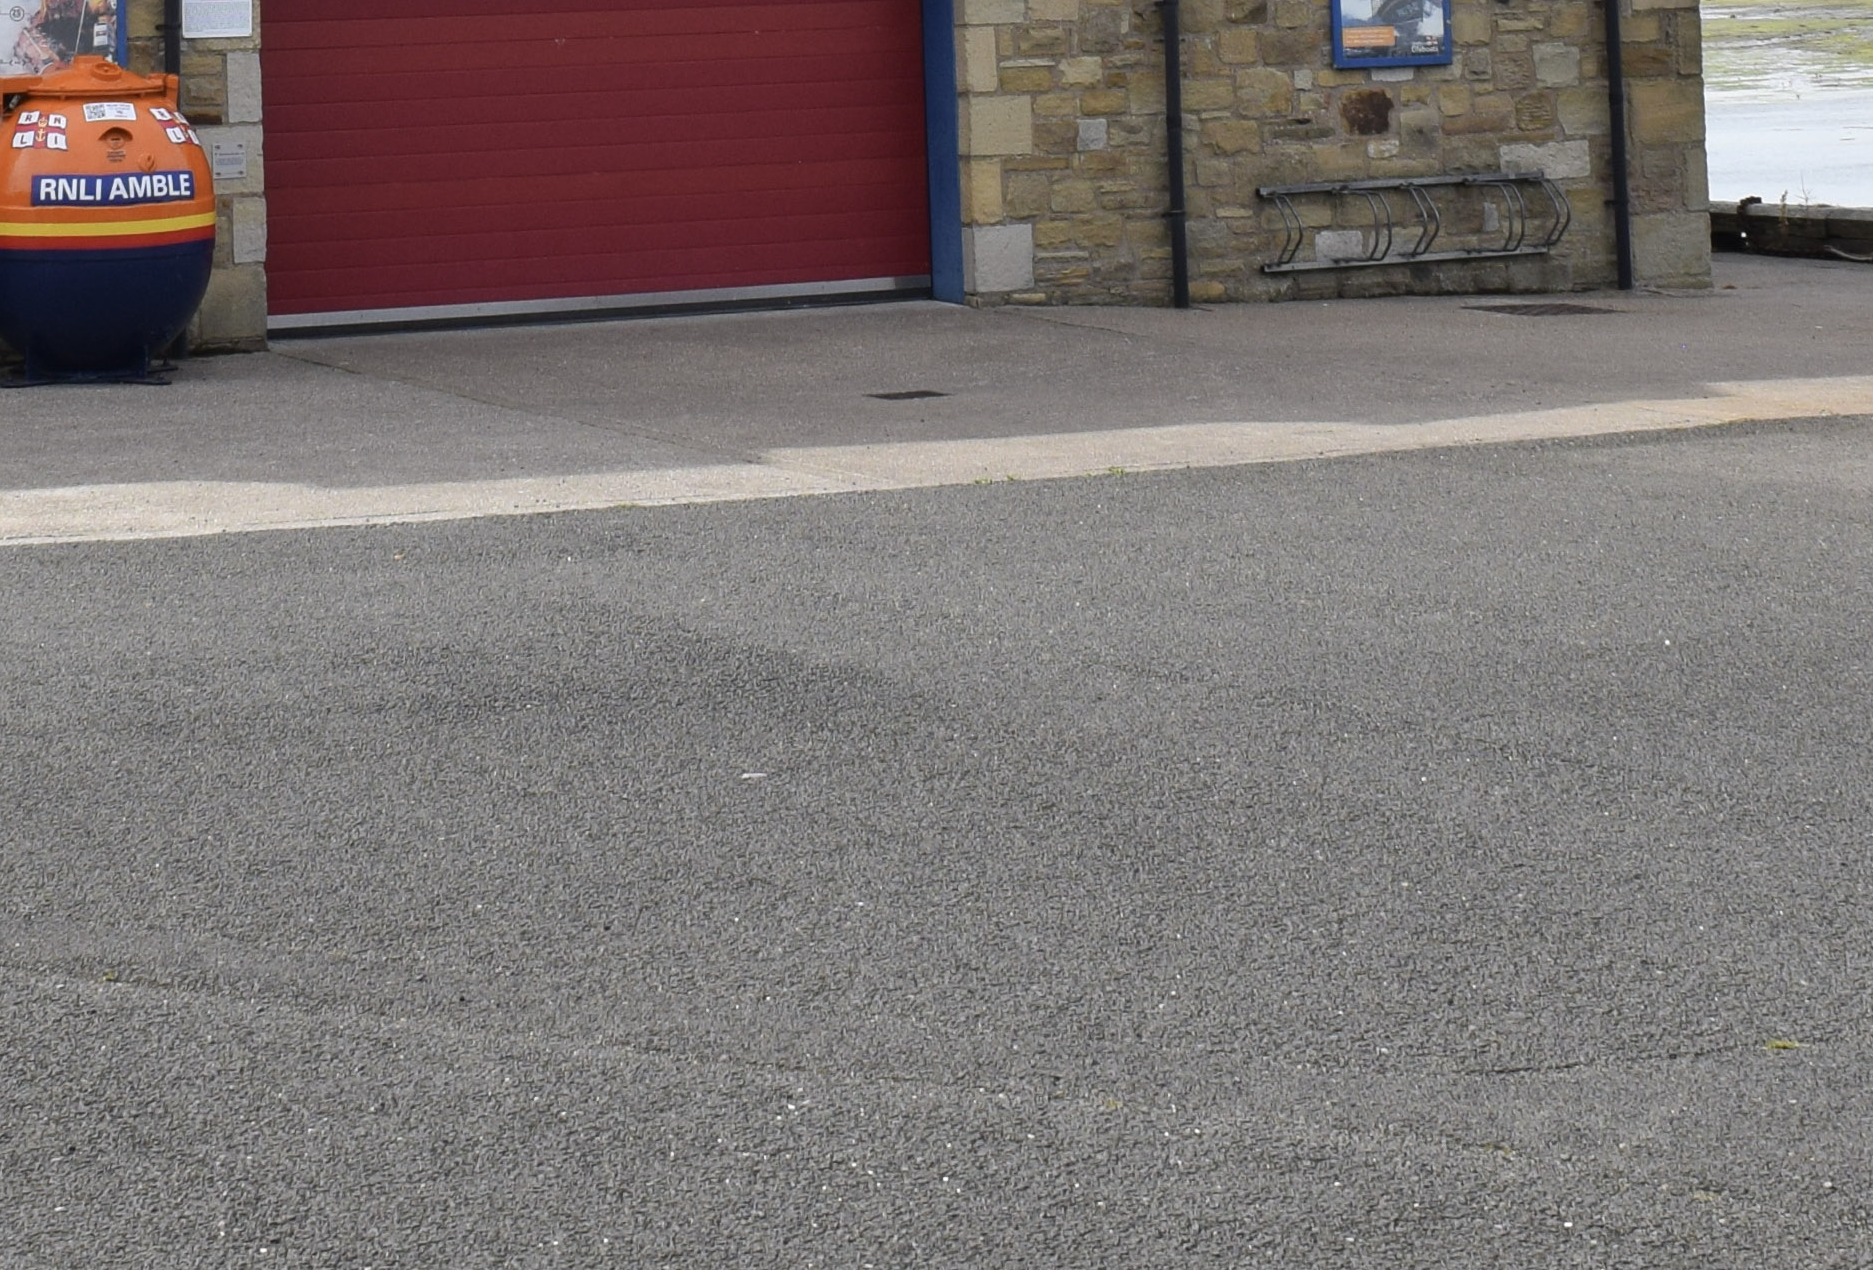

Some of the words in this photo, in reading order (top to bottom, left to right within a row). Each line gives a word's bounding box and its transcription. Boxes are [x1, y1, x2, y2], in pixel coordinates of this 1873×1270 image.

[27, 113, 32, 121] R
[20, 134, 27, 144] L
[40, 178, 102, 201] RNLI
[109, 174, 190, 201] AMBLE
